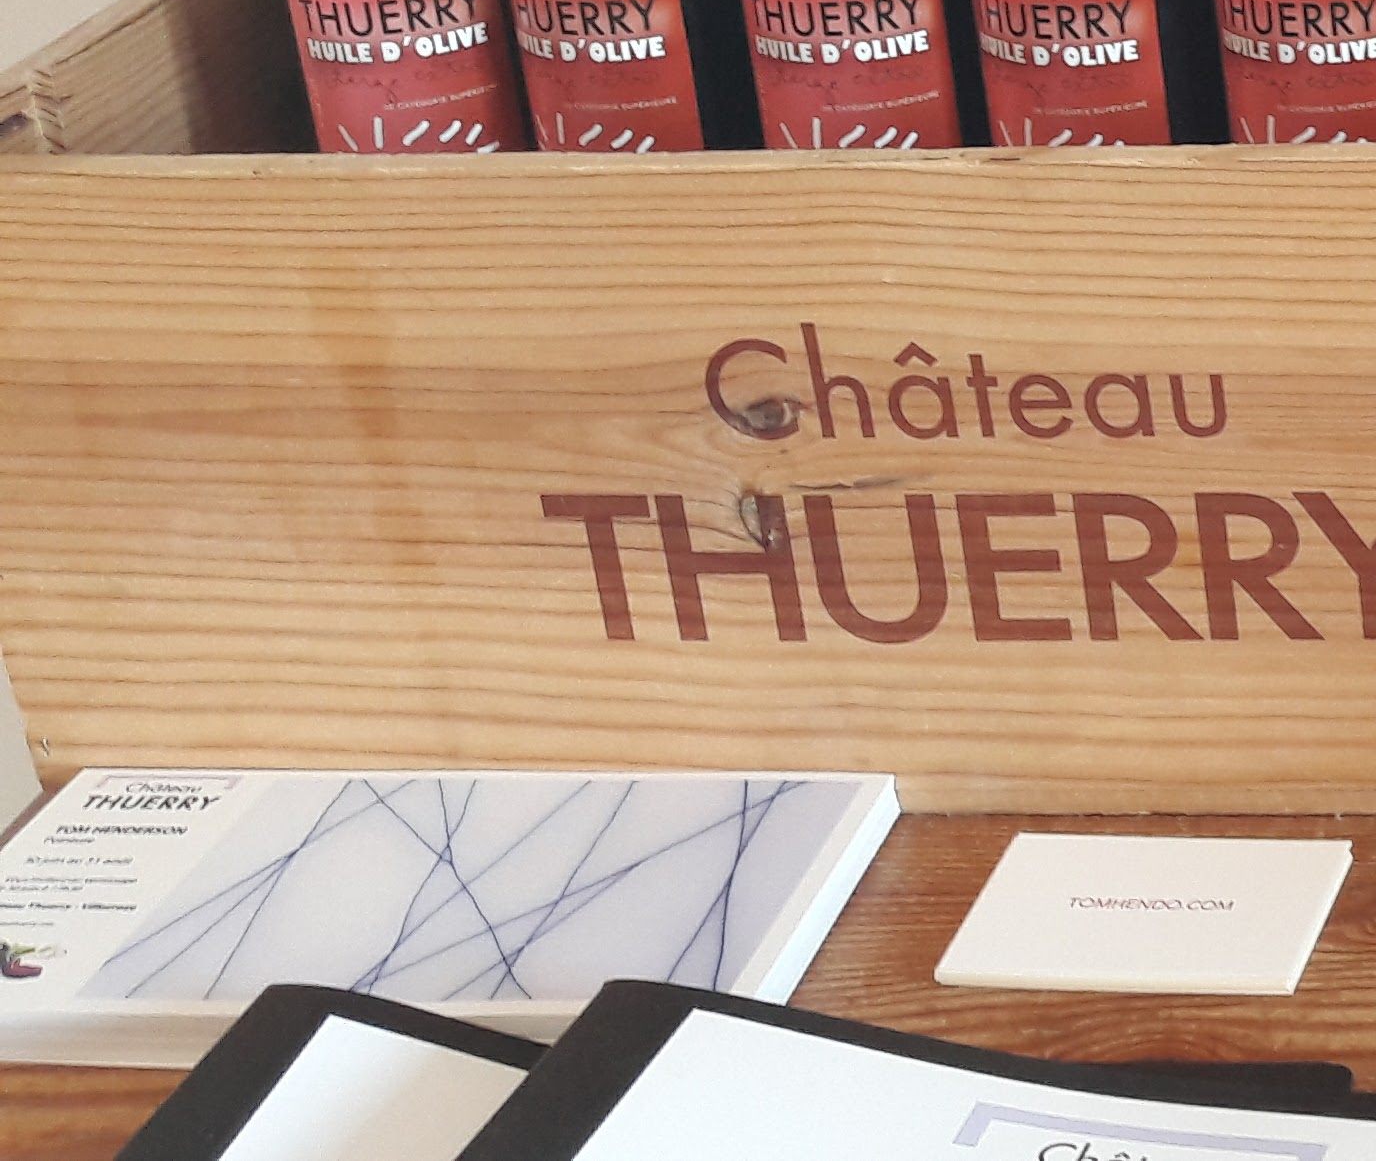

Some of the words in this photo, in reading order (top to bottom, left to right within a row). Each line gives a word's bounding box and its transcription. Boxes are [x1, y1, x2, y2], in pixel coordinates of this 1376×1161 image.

[307, 37, 374, 64] HUILE
[380, 21, 489, 64] D'OLIVE
[559, 35, 666, 63] D'OLIVE
[755, 34, 815, 64] HUILE
[820, 29, 930, 64] D'OLIVE
[1032, 39, 1139, 67] D'OLIVE
[704, 322, 1229, 441] Château
[83, 795, 222, 810] THUERRY
[1070, 897, 1236, 911] TOMHENDO.COM
